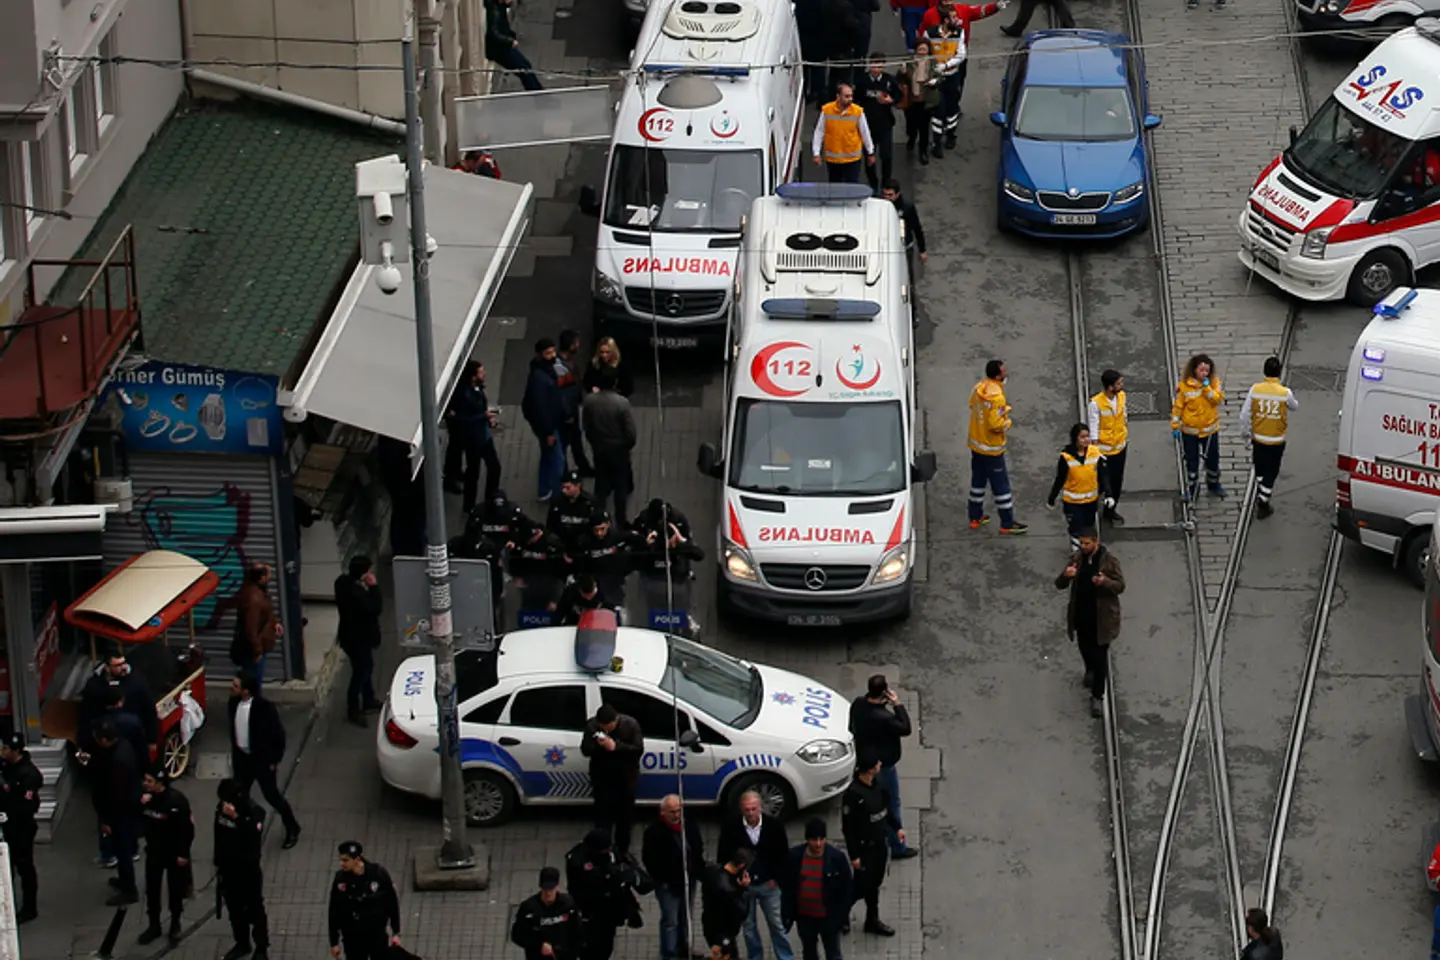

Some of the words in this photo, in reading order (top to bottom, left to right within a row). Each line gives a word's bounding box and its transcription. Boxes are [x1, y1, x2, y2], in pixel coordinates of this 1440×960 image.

[648, 118, 675, 133] 112
[768, 360, 811, 377] 112
[162, 367, 226, 391] Gümüş
[1258, 399, 1280, 415] 112
[1382, 414, 1426, 438] SAĞLIK
[637, 750, 688, 771] OLİS
